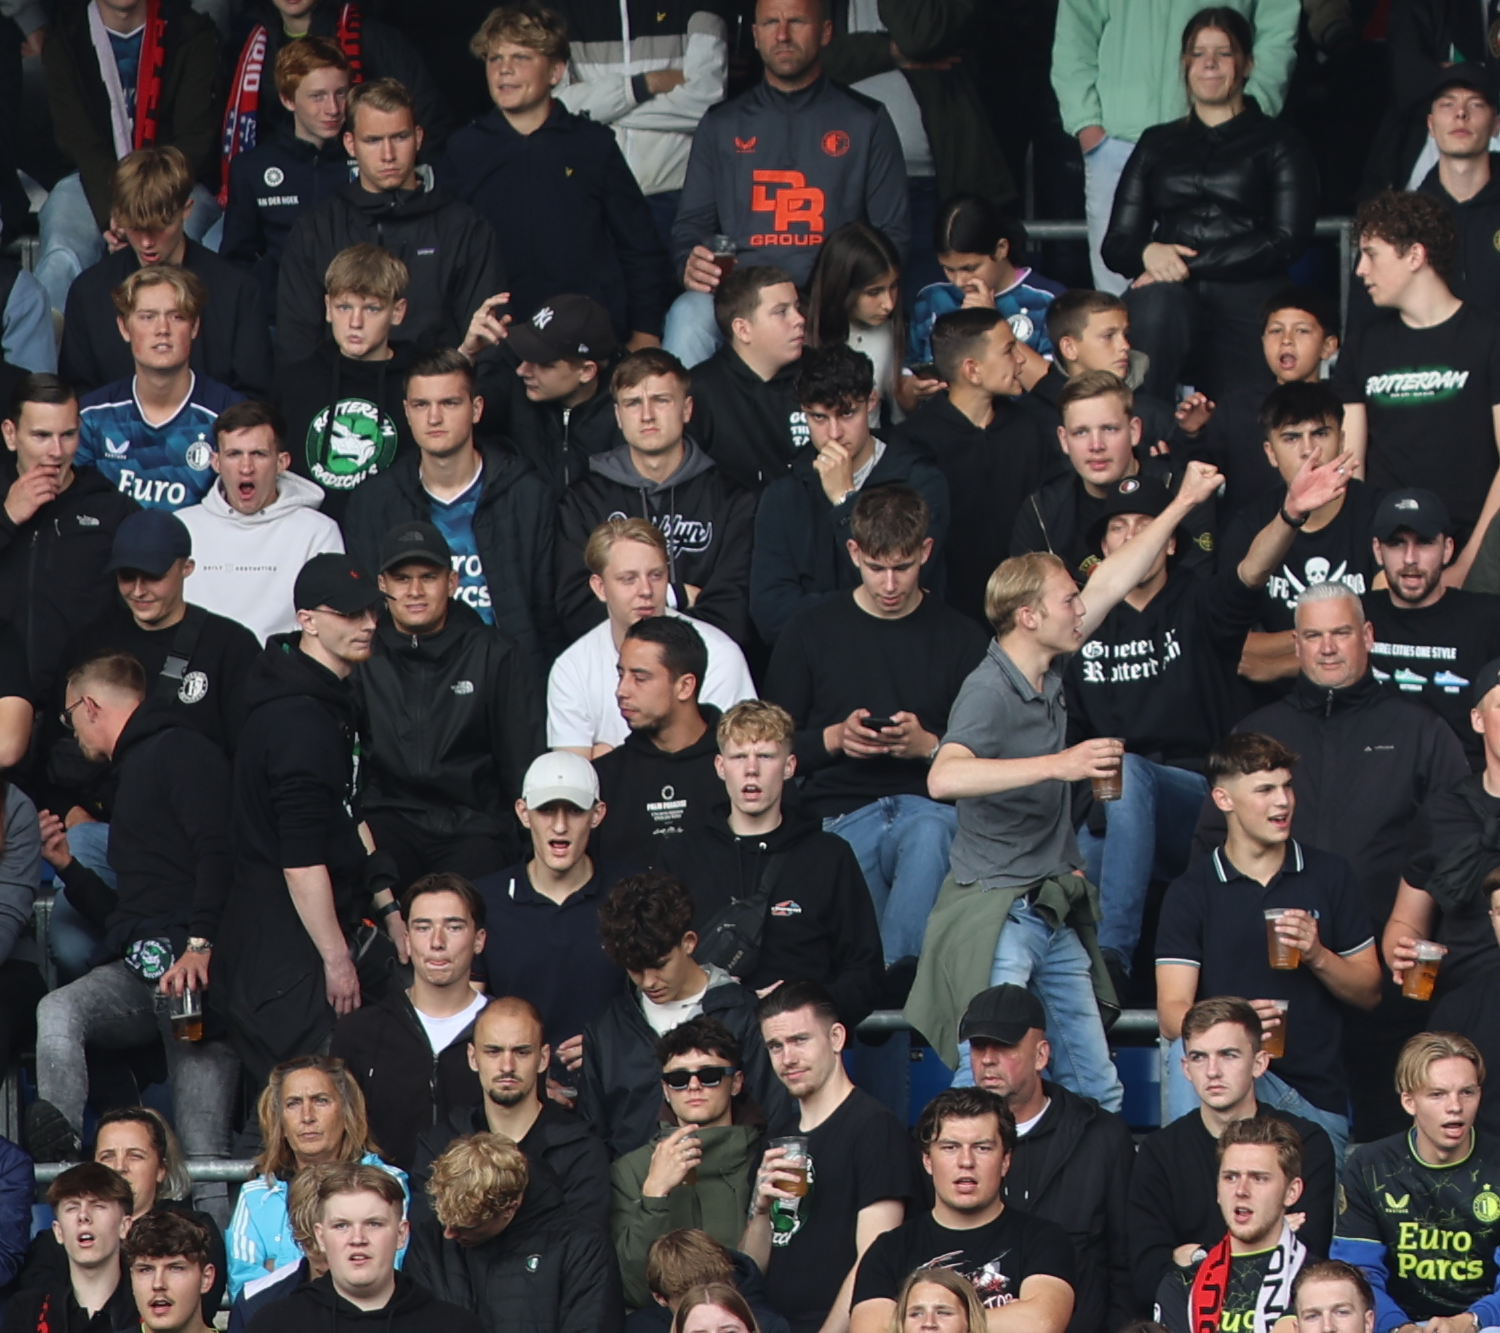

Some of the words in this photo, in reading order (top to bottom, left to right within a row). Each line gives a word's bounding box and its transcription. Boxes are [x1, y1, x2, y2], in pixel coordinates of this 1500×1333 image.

[749, 234, 823, 247] GROUP
[1365, 370, 1470, 397] ROTTERDAM
[117, 467, 189, 506] Euro
[1397, 1219, 1472, 1253] Euro
[1397, 1252, 1486, 1282] Parcs
